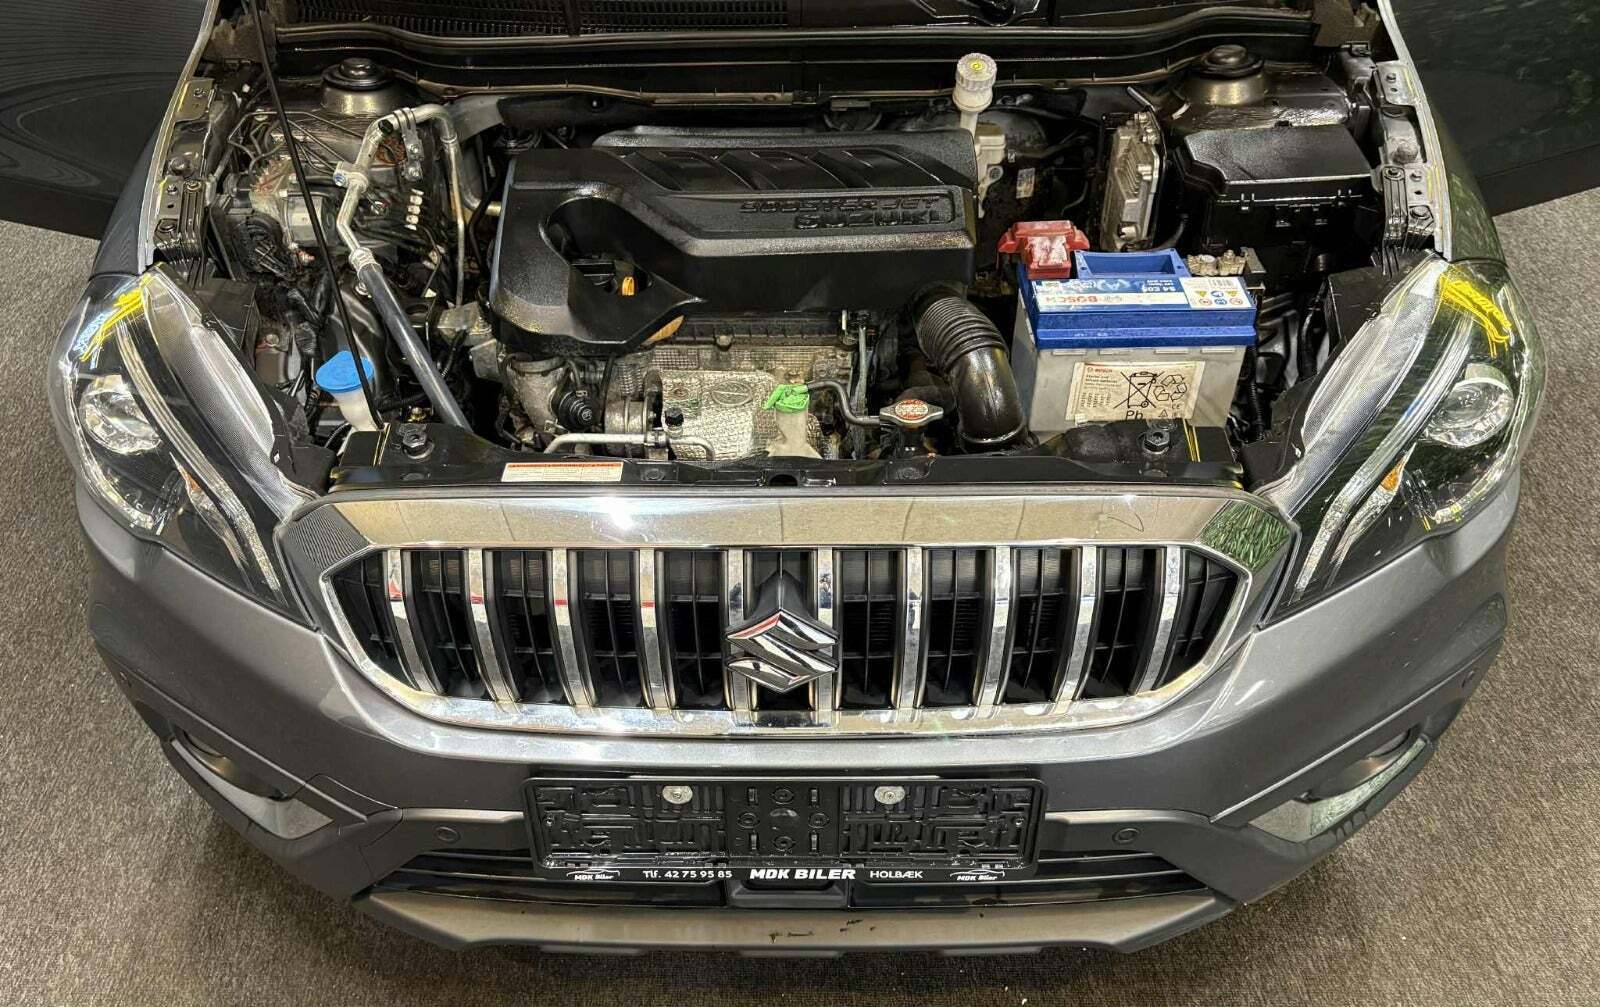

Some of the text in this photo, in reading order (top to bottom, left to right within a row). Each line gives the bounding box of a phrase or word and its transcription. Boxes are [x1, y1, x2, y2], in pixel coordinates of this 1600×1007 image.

[796, 208, 945, 229] SUZUKI
[1047, 295, 1098, 303] BOSCH
[1126, 410, 1143, 420] Pb
[643, 870, 732, 878] Tlf. 42 75 95 85
[749, 868, 856, 879] MDK BILER
[869, 870, 923, 878] HOLBÆK
